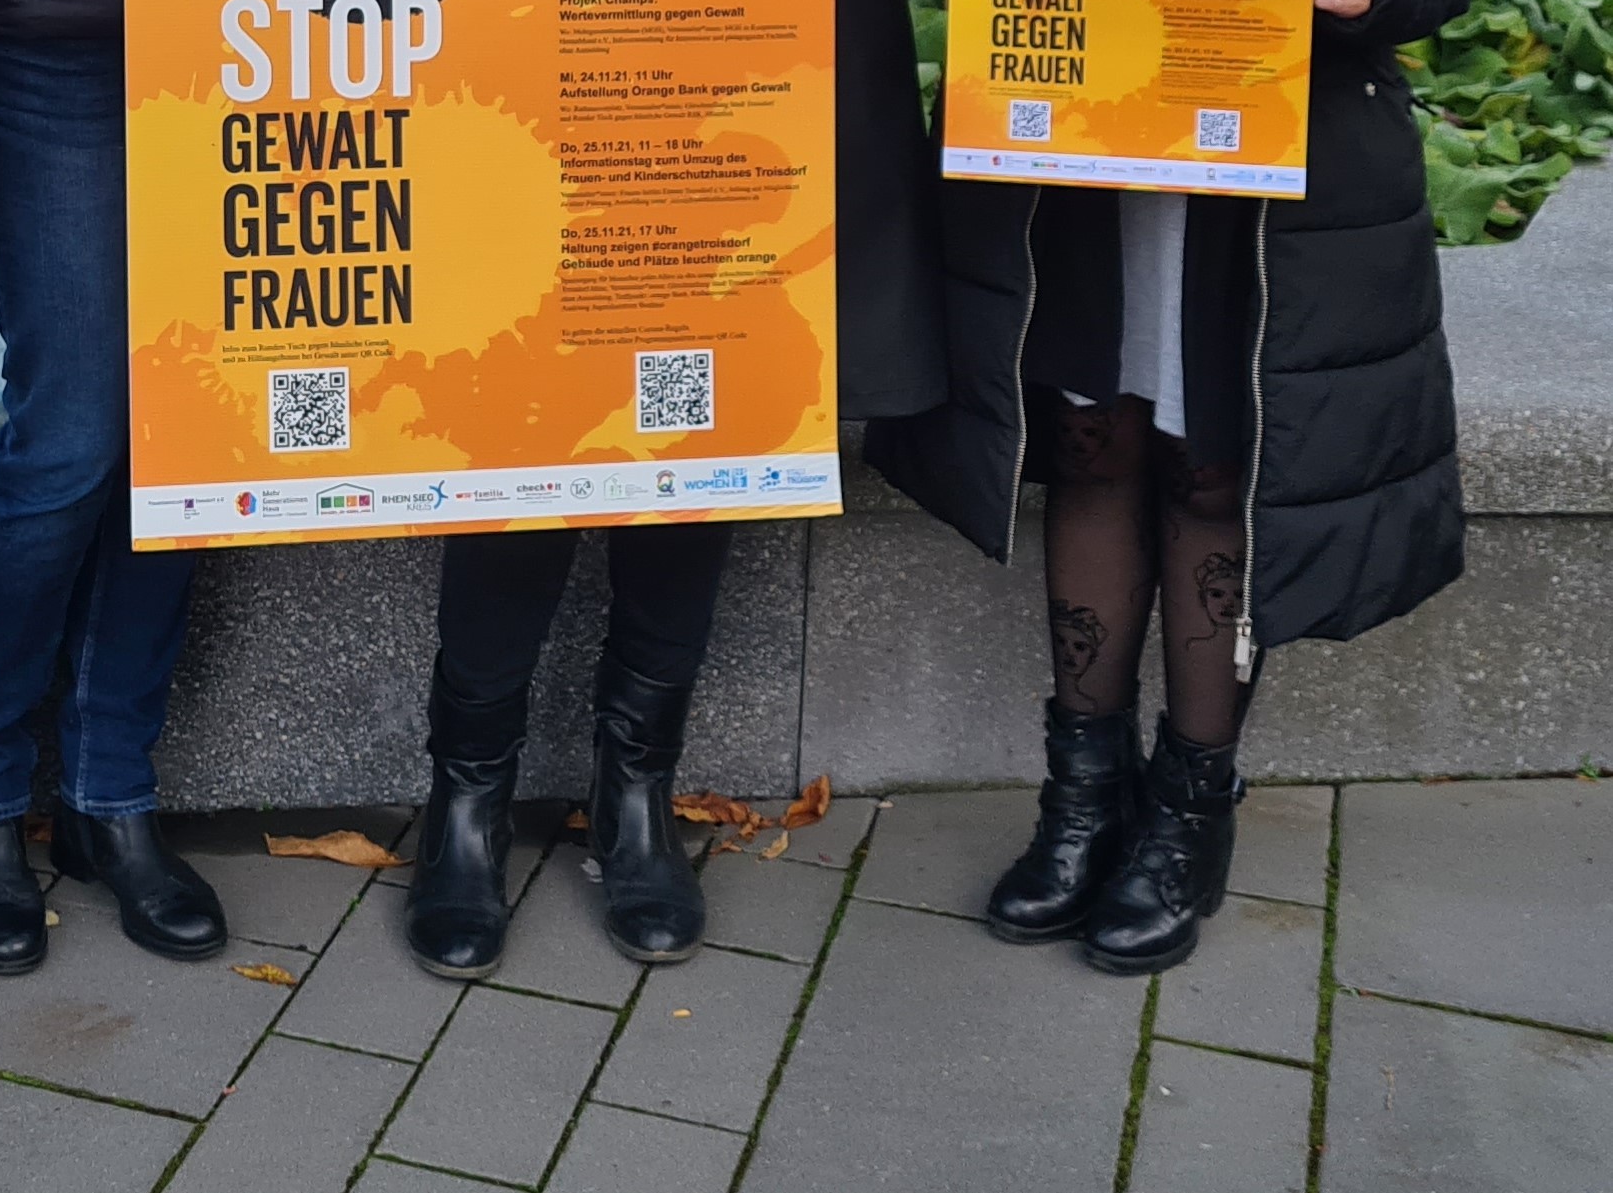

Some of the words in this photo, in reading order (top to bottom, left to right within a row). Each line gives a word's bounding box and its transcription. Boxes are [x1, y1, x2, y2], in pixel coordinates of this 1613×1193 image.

[559, 9, 661, 21] Wertevermittlung
[665, 10, 701, 21] gegen
[705, 7, 744, 17] Gewalt
[992, 13, 1085, 51] GEGEN
[991, 53, 1084, 85] FRAUEN
[560, 72, 577, 84] Mi,
[580, 71, 631, 82] 24.11.21,
[635, 71, 647, 81] 11
[652, 70, 673, 80] Uhr
[560, 87, 628, 99] Aufstellung
[632, 86, 674, 98] Orange
[679, 84, 708, 95] Bank
[712, 85, 747, 96] gegen
[751, 82, 791, 92] Gewalt
[222, 109, 410, 173] GEWALT
[561, 143, 580, 154] Do,
[583, 141, 634, 153] 25.11.21,
[639, 141, 650, 150] 11
[665, 139, 678, 150] 18
[682, 139, 703, 149] Uhr
[561, 157, 652, 168] Informationstag
[655, 157, 679, 165] zum
[683, 154, 723, 165] Umzug
[726, 153, 747, 163] des
[561, 173, 605, 183] Frauen-
[609, 172, 631, 182] und
[634, 169, 751, 181] Kinderschutzhauses
[755, 165, 807, 177] Troisdorf
[224, 179, 410, 257] GEGEN
[561, 229, 580, 239] Do,
[584, 226, 635, 237] 25.11.21,
[639, 225, 652, 236] 17
[656, 225, 677, 236] Uhr
[561, 244, 607, 255] Haltung
[610, 241, 649, 254] zeigen
[652, 237, 750, 252] #orangetroisdorf
[561, 258, 614, 269] Gebäude
[618, 257, 640, 267] und
[644, 256, 679, 265] Plätze
[683, 254, 733, 264] leuchten
[736, 254, 776, 264] orange
[224, 264, 411, 331] FRAUEN
[713, 468, 730, 478] UN
[684, 479, 730, 490] WOMEN
[381, 494, 411, 504] RHEIN
[412, 493, 434, 502] SIEG
